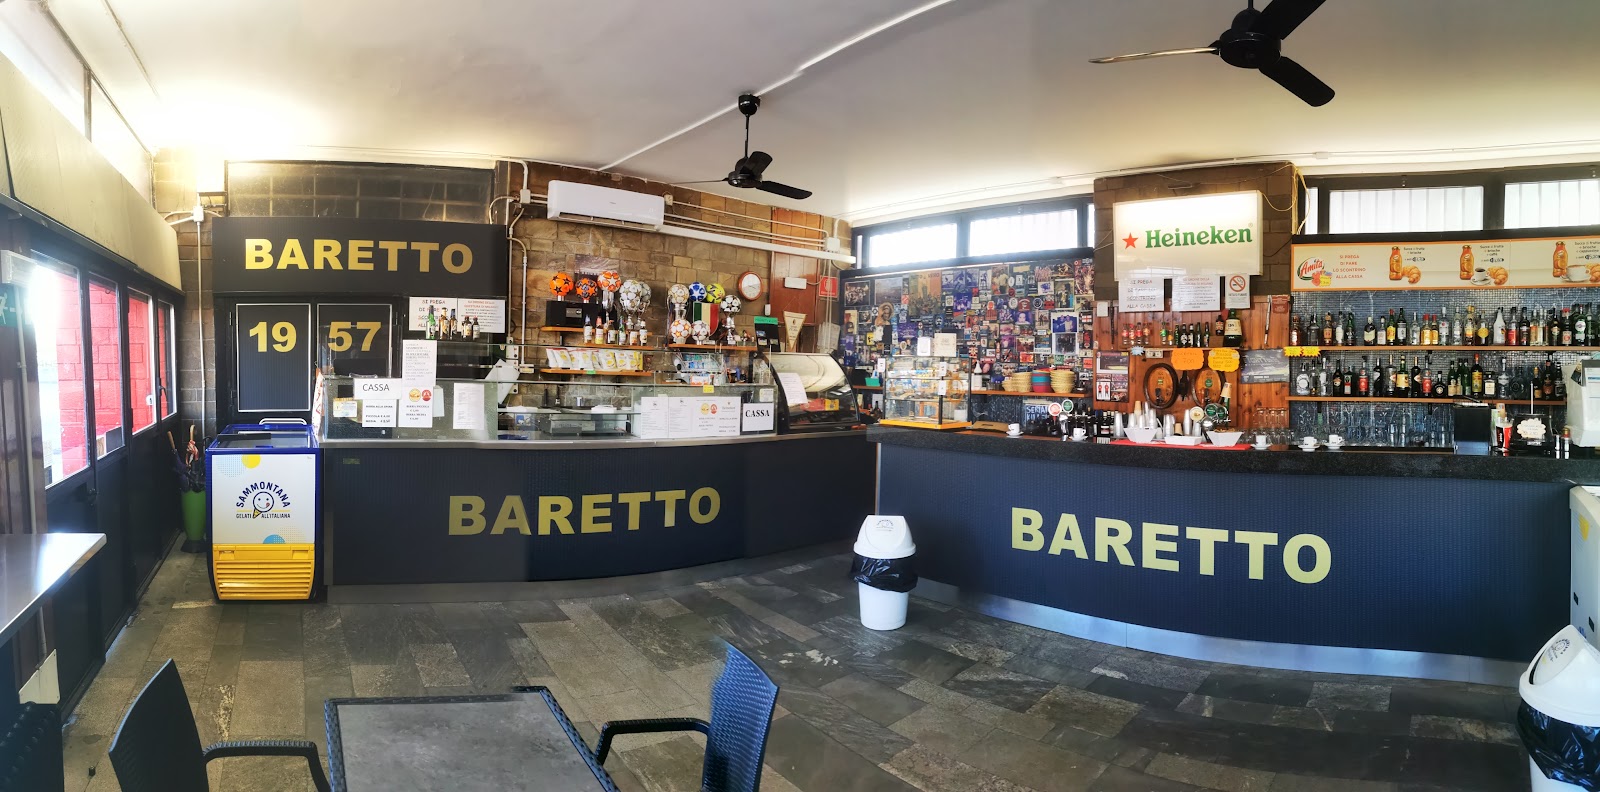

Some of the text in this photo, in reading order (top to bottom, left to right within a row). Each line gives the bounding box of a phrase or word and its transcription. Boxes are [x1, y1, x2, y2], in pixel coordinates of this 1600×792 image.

[1145, 226, 1252, 248] Heineken
[244, 238, 473, 274] BARETTO
[1299, 259, 1323, 279] Amita
[249, 321, 297, 353] 19
[328, 321, 382, 352] 57
[745, 409, 770, 418] CASSA
[236, 482, 290, 508] SAMMONTANA
[448, 486, 720, 536] BARETTO
[1012, 506, 1332, 584] BARETTO
